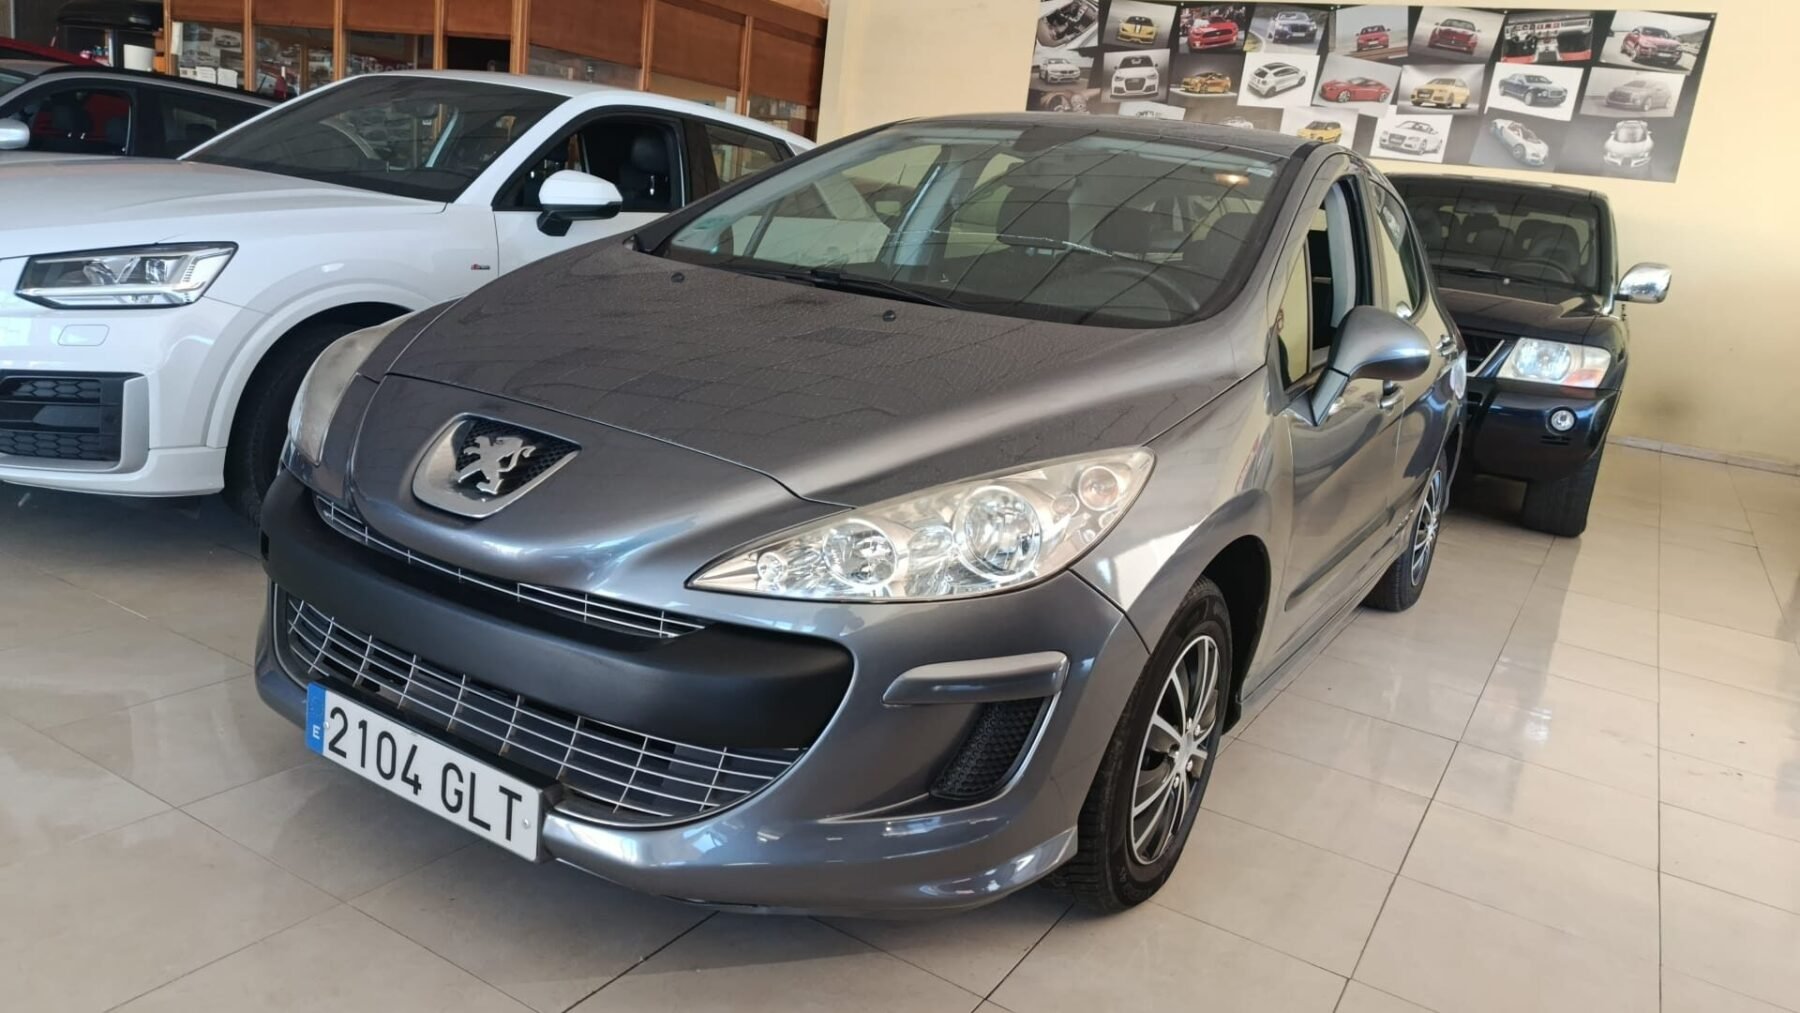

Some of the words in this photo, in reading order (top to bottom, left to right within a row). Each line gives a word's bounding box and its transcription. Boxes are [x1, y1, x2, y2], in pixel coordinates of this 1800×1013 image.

[312, 725, 321, 740] E
[328, 706, 422, 796] 2104
[440, 762, 522, 842] GLT
